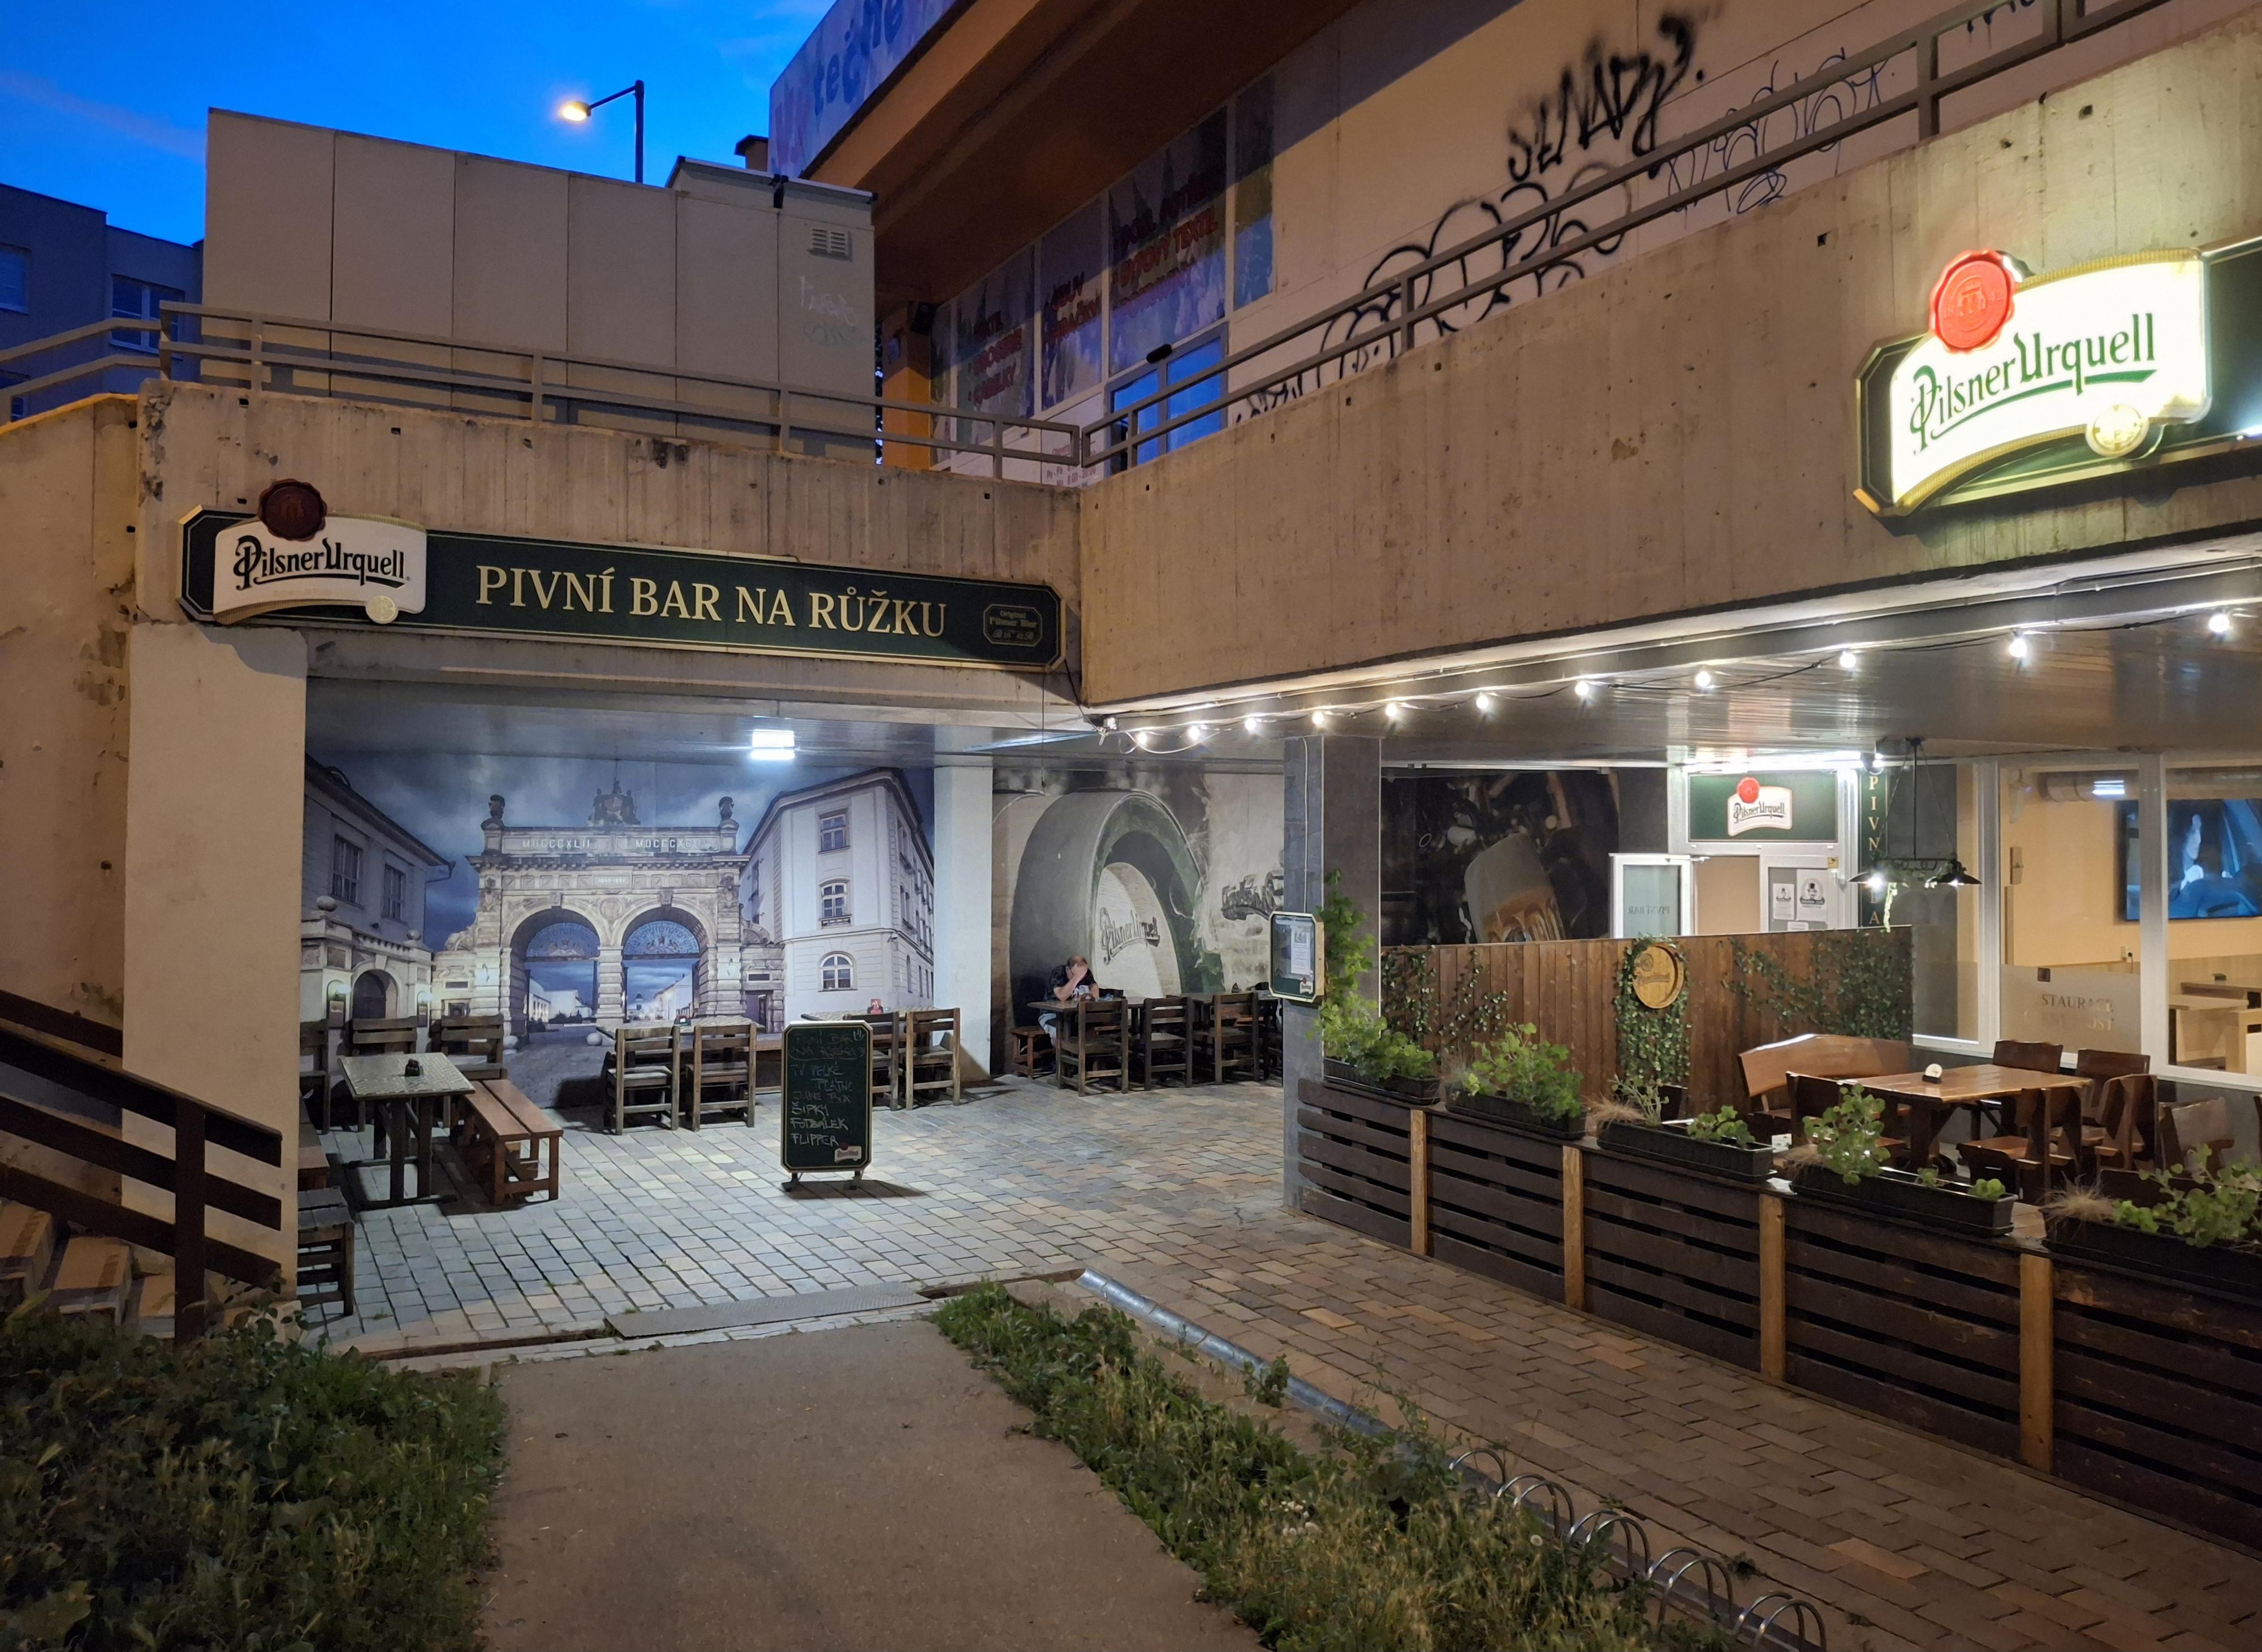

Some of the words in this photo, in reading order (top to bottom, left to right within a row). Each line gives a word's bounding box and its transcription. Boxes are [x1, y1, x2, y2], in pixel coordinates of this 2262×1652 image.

[1910, 359, 2016, 455] Pilsner
[2014, 313, 2156, 395] Urquell
[234, 536, 323, 590] Pilsner
[322, 537, 405, 586] Urquell
[476, 566, 615, 614] PIVNÍ
[629, 578, 722, 622] BAR
[736, 586, 796, 627] NA
[809, 586, 946, 637] RŮŽKU
[1733, 803, 1759, 823] Pilsner
[1759, 801, 1785, 818] Urquell
[1868, 776, 1880, 860] PIVN
[1099, 907, 1132, 965] Pilsner
[791, 1101, 829, 1116] ŠIPKY
[791, 1133, 839, 1147] FLIPPER
